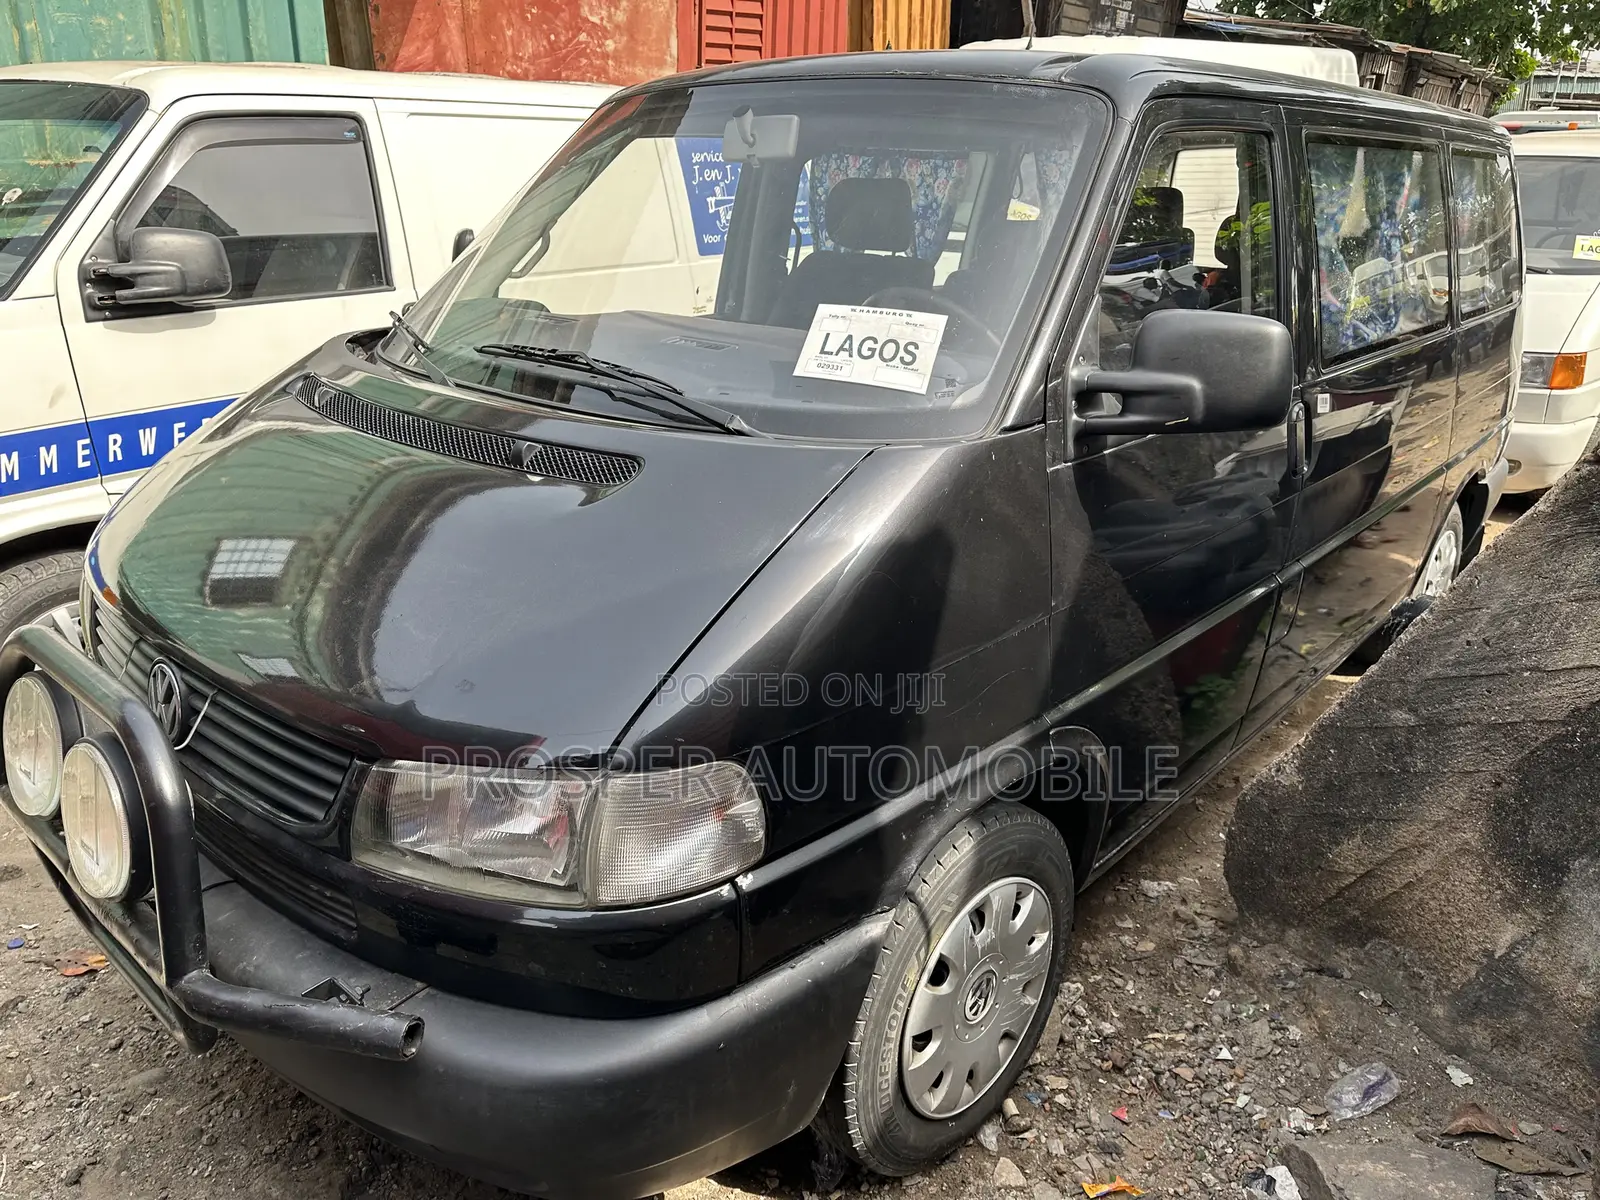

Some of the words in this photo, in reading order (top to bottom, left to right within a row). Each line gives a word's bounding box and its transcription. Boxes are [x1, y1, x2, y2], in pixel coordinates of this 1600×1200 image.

[859, 309, 904, 317] HAMBURG
[819, 332, 919, 366] LAGOS
[0, 417, 212, 483] MMERWE
